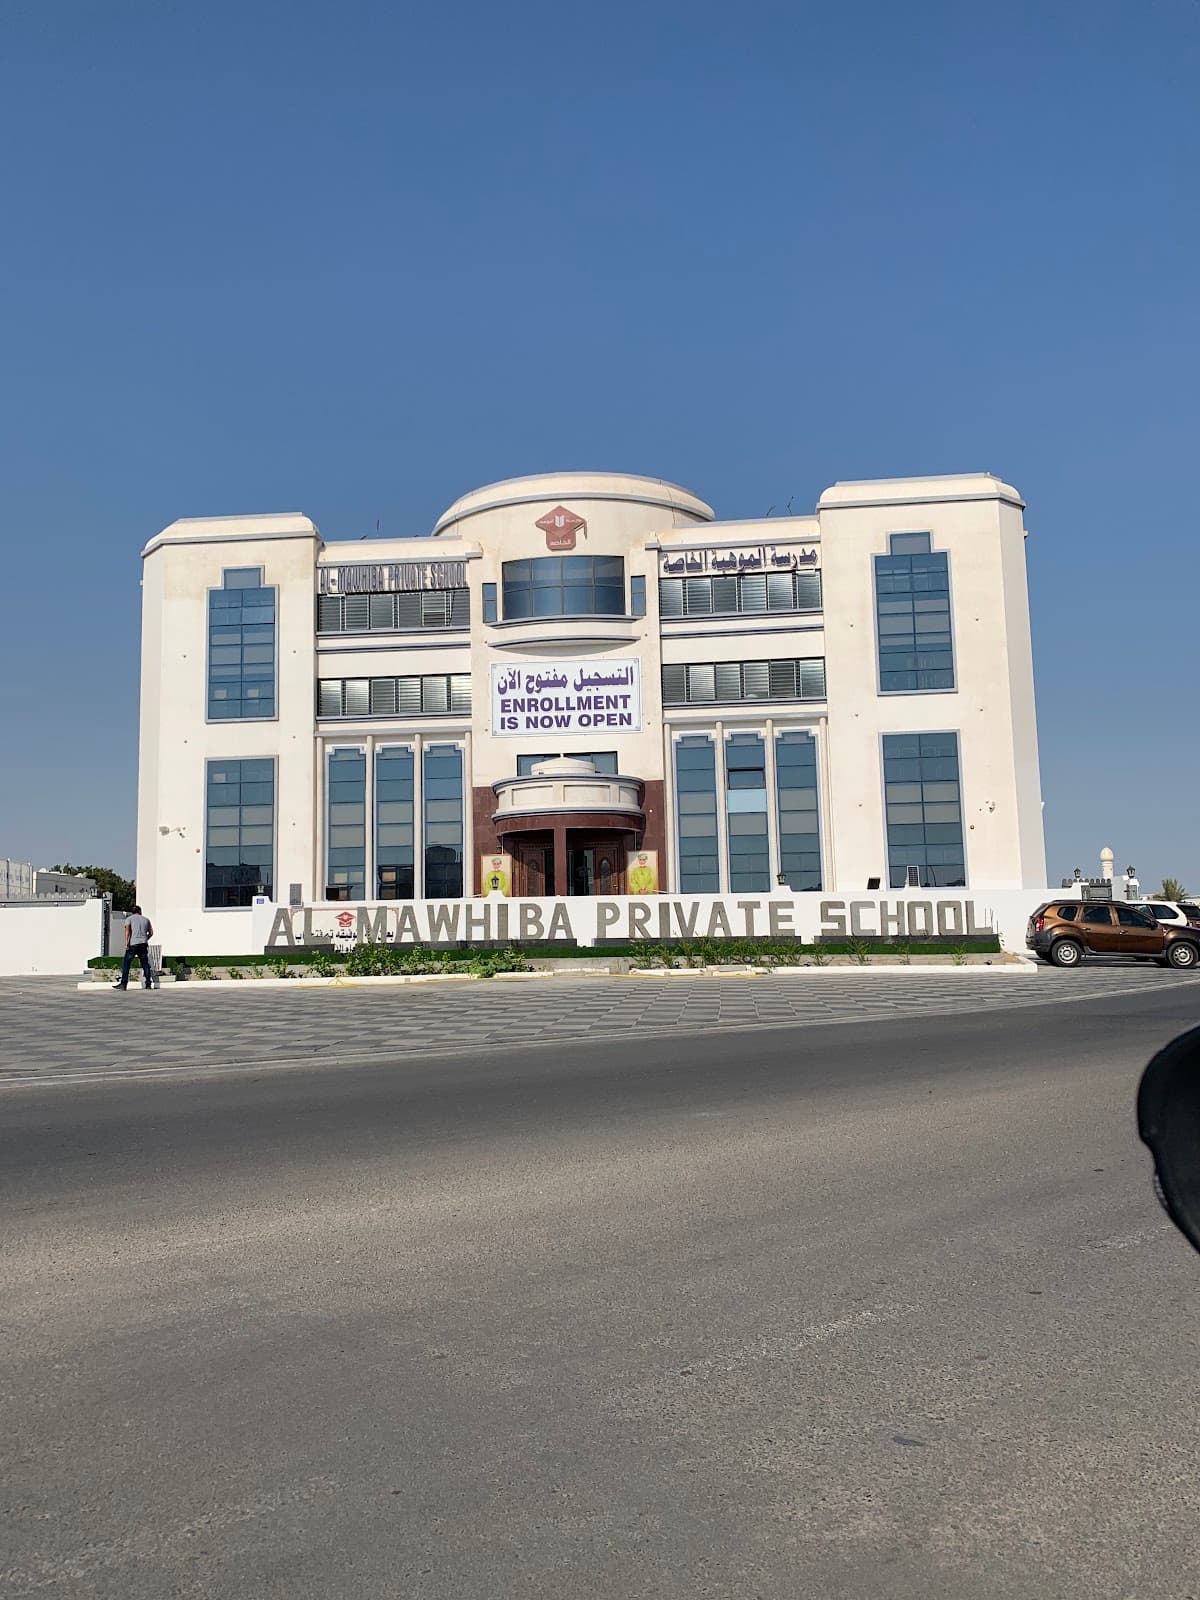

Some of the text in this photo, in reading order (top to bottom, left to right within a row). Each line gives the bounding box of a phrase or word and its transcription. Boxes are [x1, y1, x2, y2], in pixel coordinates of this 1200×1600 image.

[430, 562, 467, 588] SCHOOL
[525, 668, 569, 694] مفتوح
[573, 666, 634, 692] التسجيل
[500, 695, 631, 714] ENROLLMENT
[500, 713, 632, 730] IS NOW OPEN
[267, 900, 992, 946] AL MAWHIBA PRIVATE SCHOOL
